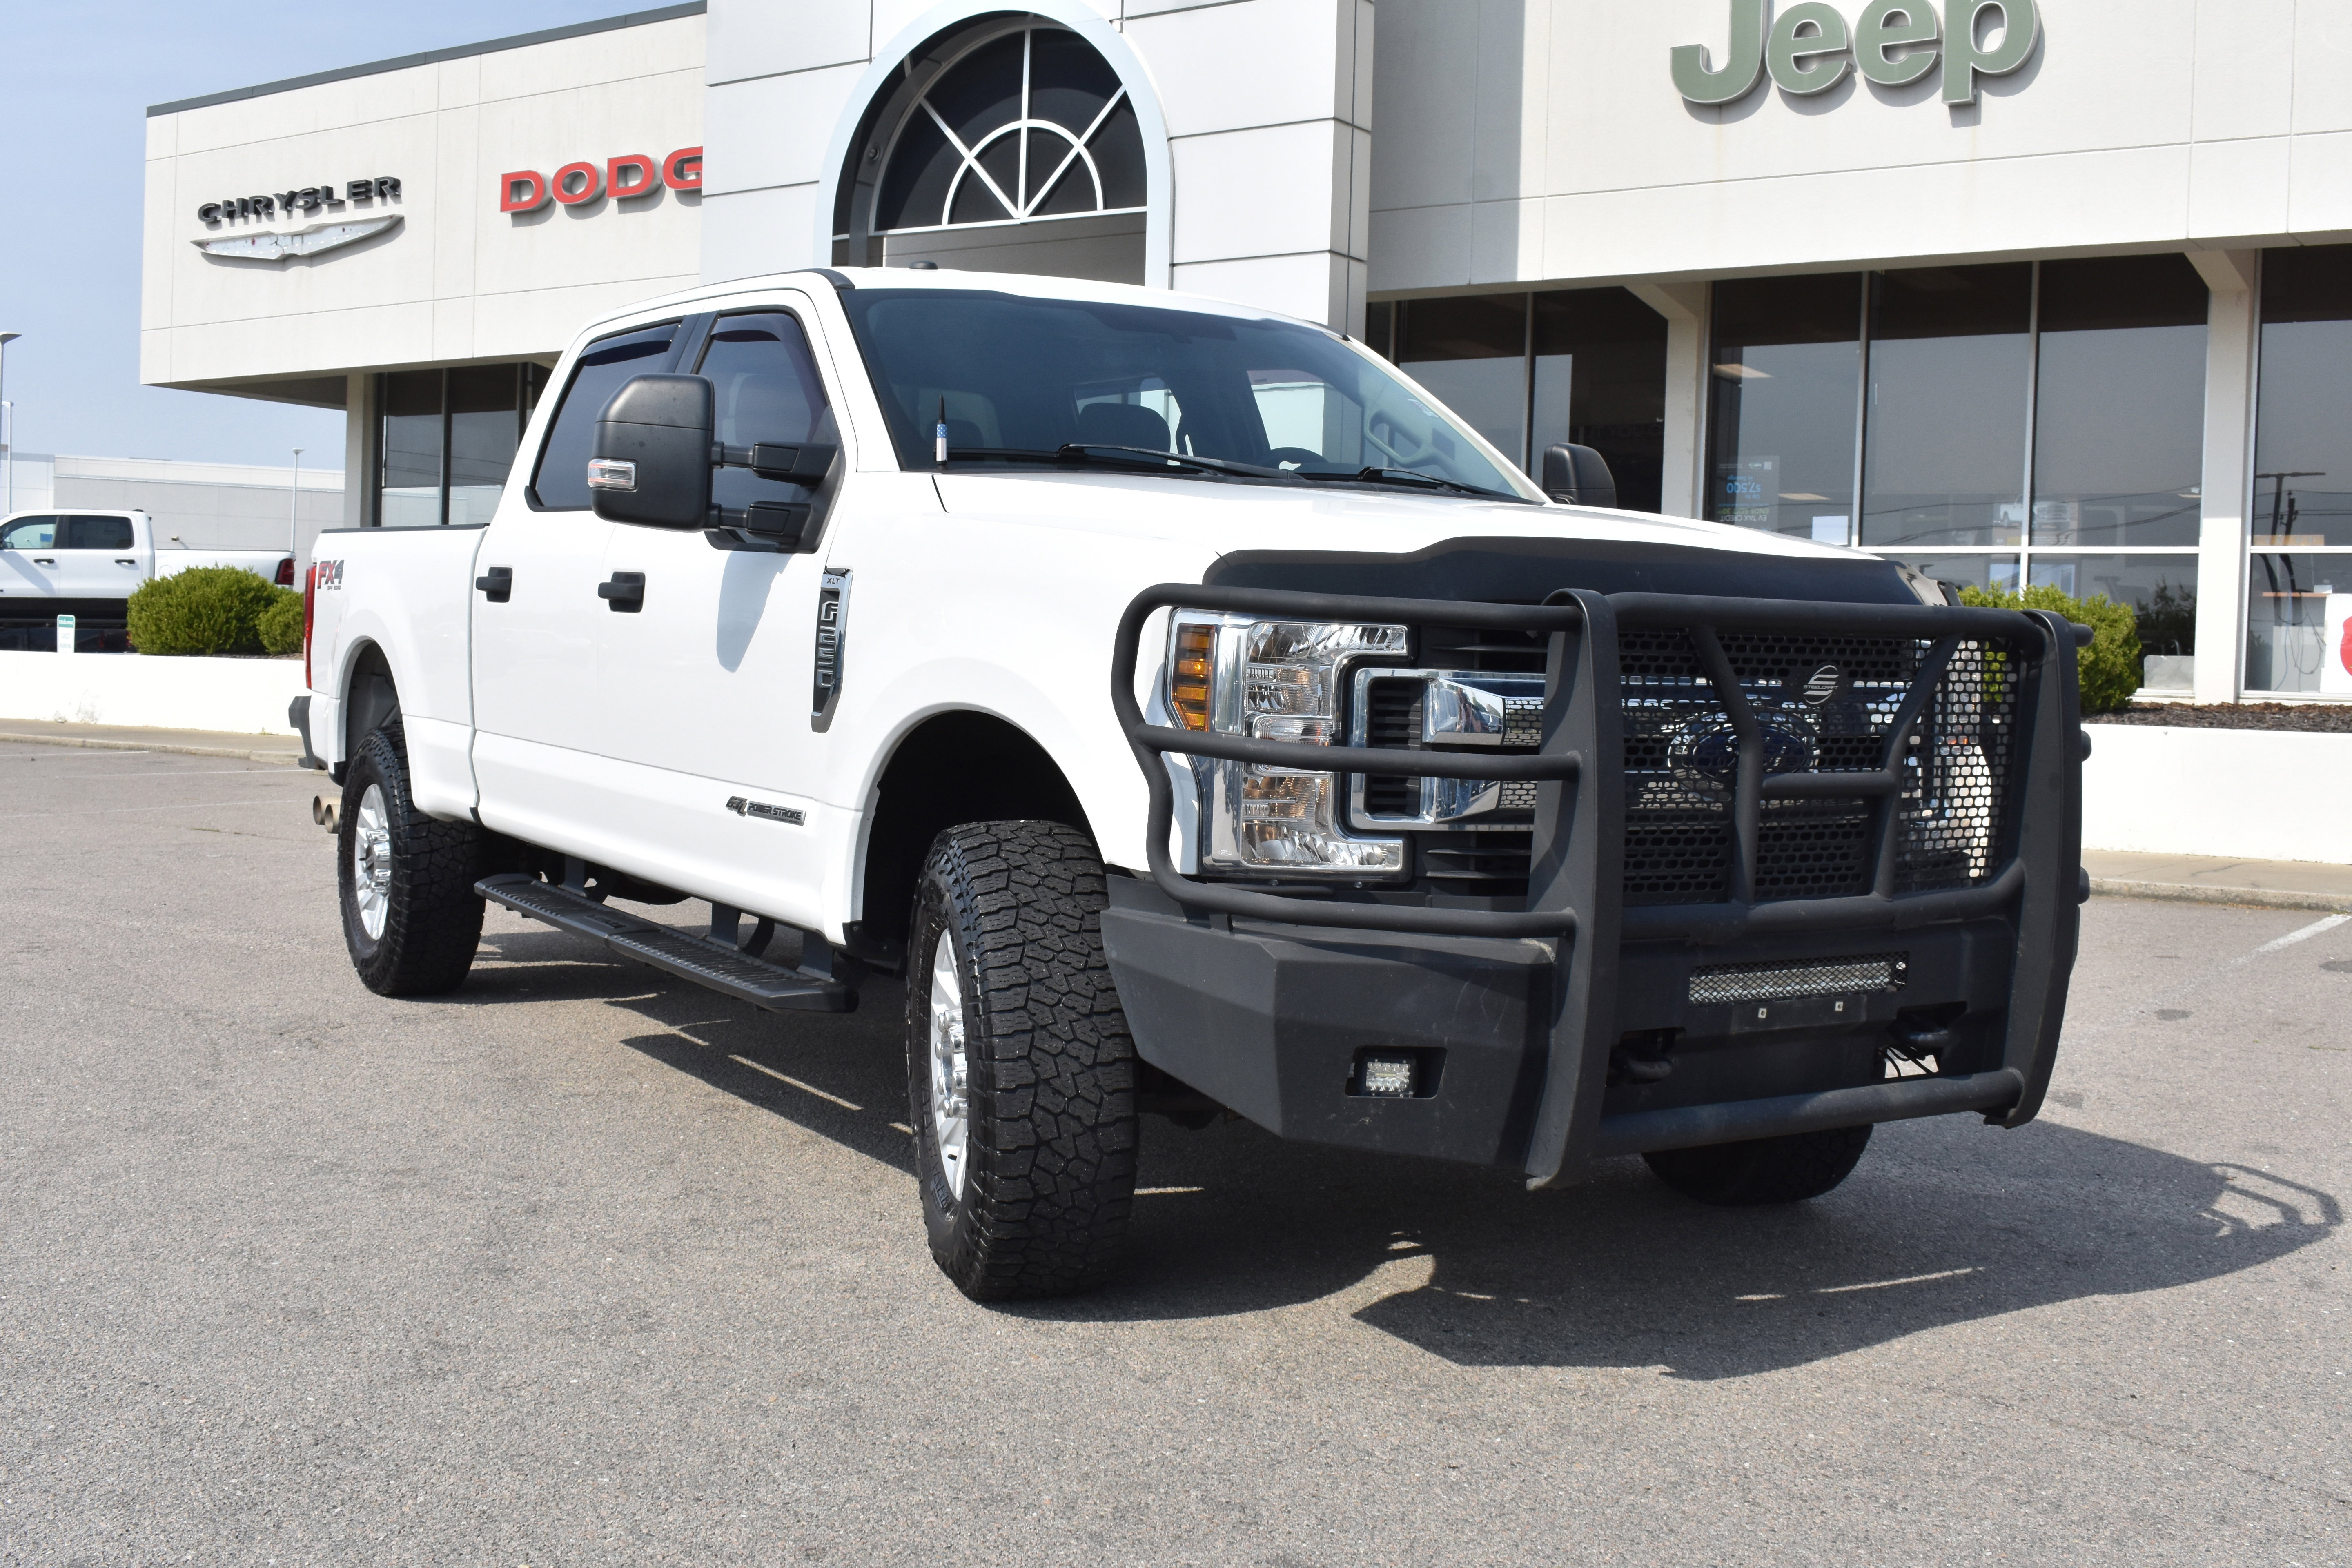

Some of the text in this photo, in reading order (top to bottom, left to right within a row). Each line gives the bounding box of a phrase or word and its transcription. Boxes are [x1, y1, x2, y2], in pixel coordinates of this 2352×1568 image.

[1670, 0, 2038, 105] Jeep
[198, 176, 401, 223] CHRYSLER
[1726, 482, 1762, 494] $7,500
[317, 559, 345, 589] FX4
[748, 802, 802, 820] POWER STROKE
